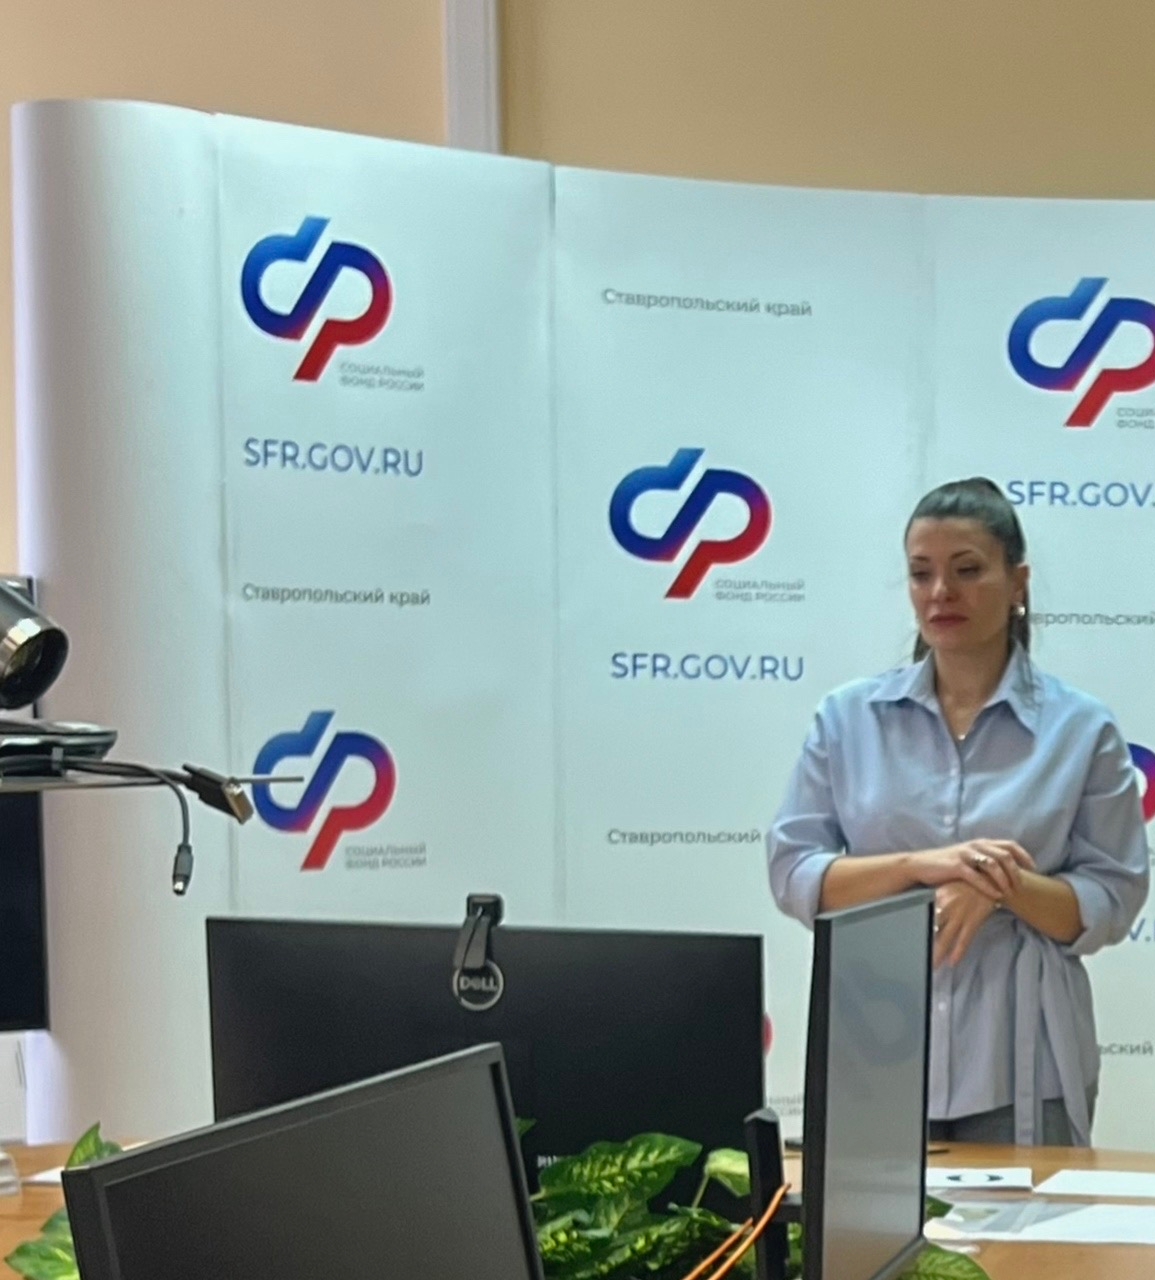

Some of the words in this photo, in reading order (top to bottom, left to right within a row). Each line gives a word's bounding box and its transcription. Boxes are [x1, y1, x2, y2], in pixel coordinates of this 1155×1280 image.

[601, 288, 760, 312] Ставропольский
[765, 301, 812, 317] край
[244, 438, 423, 477] SFR.GOV.RU
[242, 583, 384, 604] Ставропольский
[389, 590, 430, 607] край
[714, 579, 805, 592] СОЦИАЛЬНЫЙ
[611, 652, 803, 681] SFR.GOV.RU
[607, 828, 761, 846] Ставропольский
[459, 976, 497, 991] DELL
